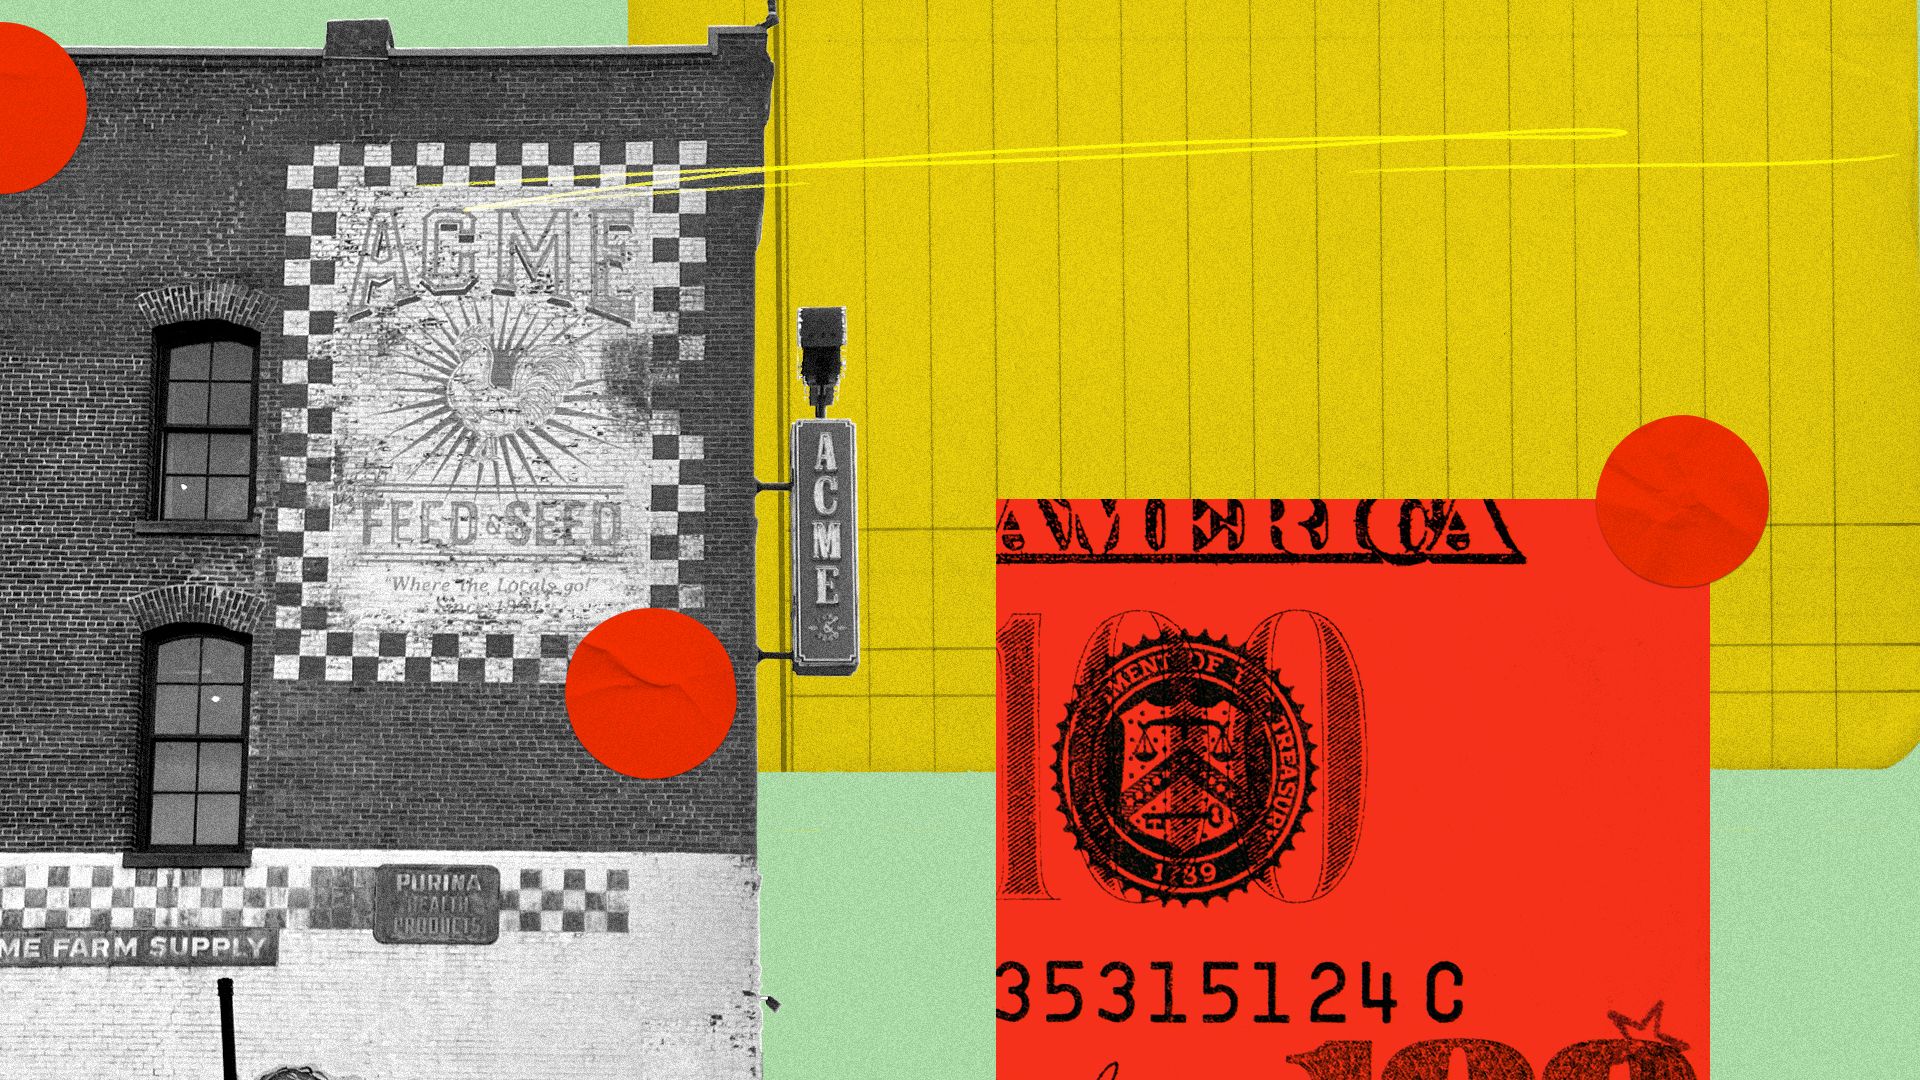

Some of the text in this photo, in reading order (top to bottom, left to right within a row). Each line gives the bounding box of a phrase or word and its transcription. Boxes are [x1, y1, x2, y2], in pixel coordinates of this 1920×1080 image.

[347, 208, 637, 327] ACME
[360, 500, 623, 547] FEED & SEED
[811, 431, 842, 605] ACME
[459, 577, 489, 593] the
[497, 576, 558, 594] Locals
[396, 873, 481, 892] PURINA
[52, 937, 138, 958] FARM
[149, 937, 266, 959] SUPPLY
[995, 960, 1398, 1024] 35315124
